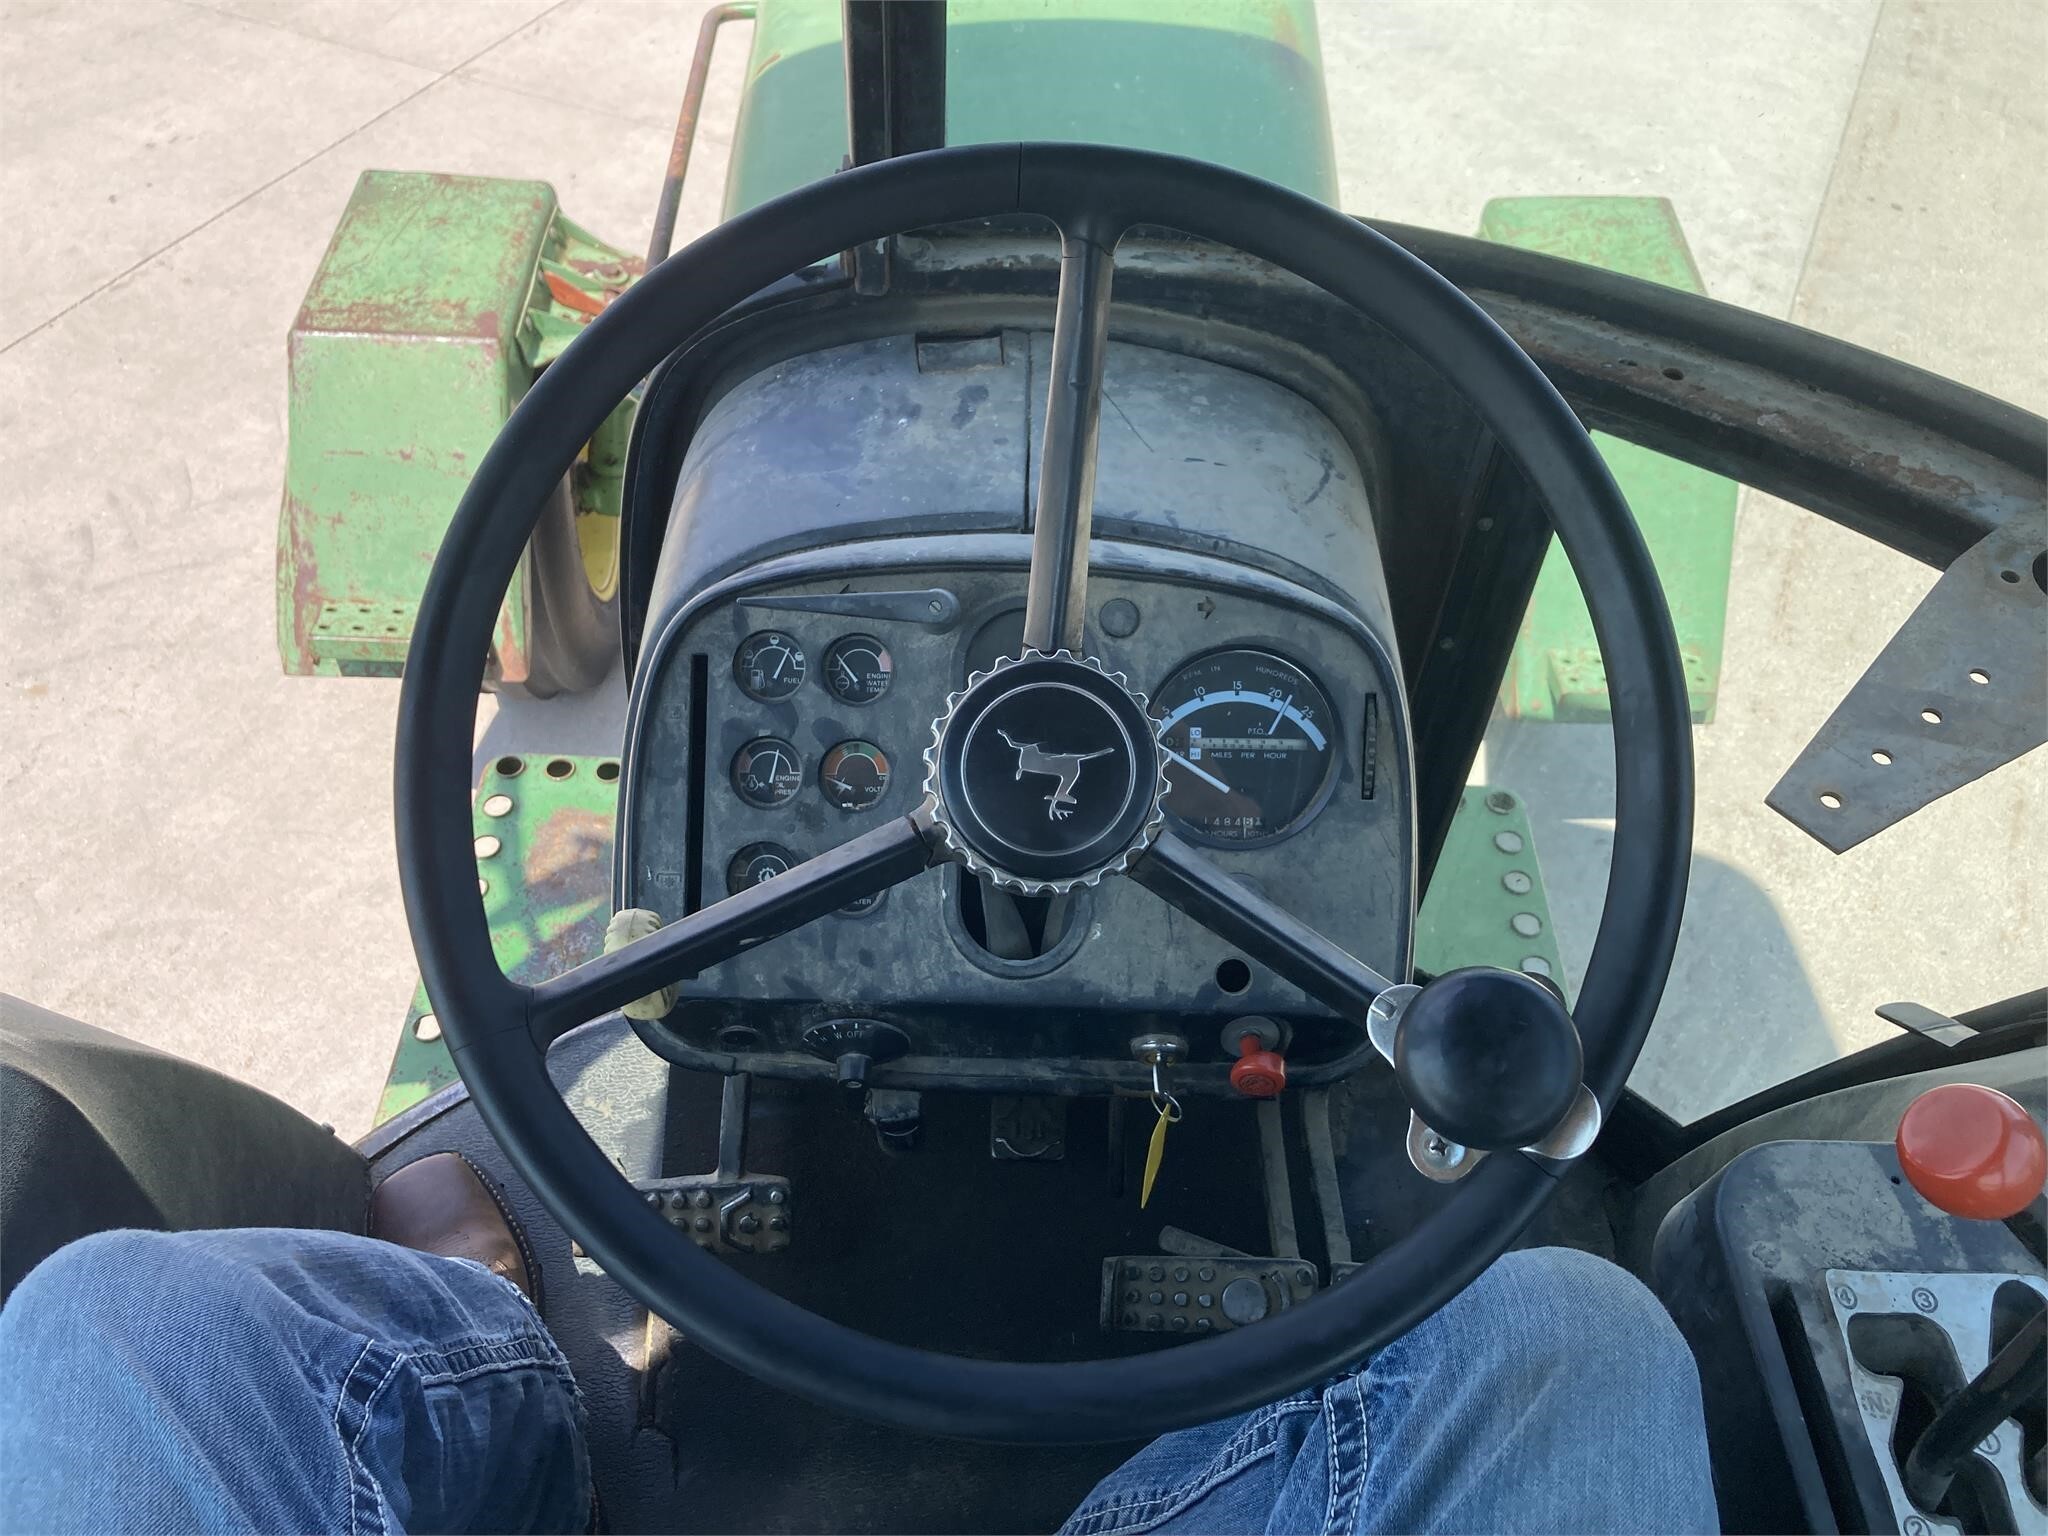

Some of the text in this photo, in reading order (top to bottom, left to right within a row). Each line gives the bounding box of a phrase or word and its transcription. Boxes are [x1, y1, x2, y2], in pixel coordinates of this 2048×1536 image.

[1255, 665, 1299, 685] HUNDREDS
[1161, 681, 1316, 719] 5 10 15 20 25
[846, 1030, 863, 1038] OFF
